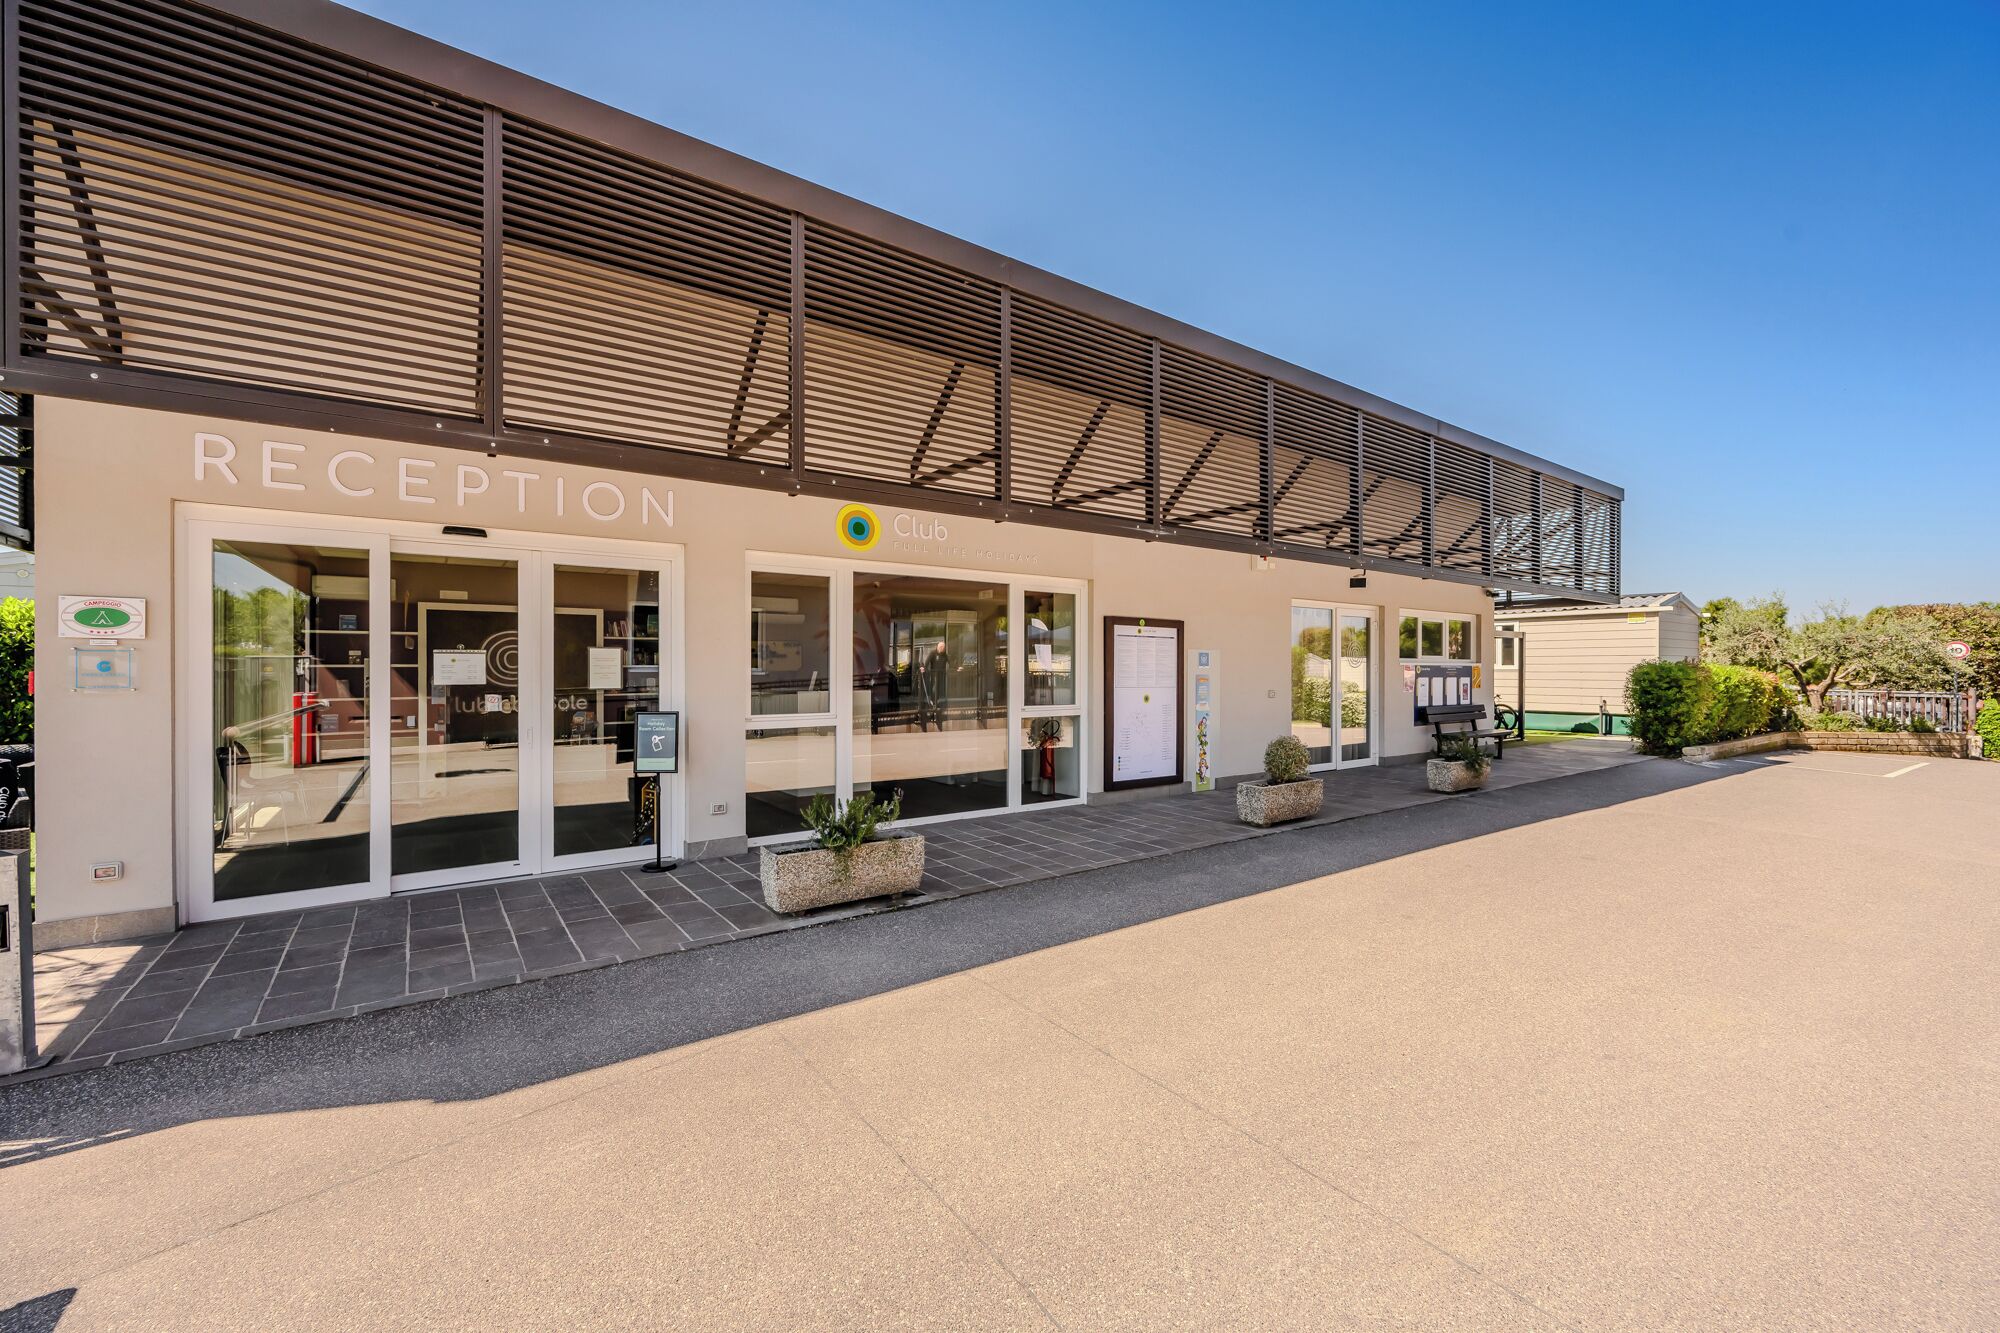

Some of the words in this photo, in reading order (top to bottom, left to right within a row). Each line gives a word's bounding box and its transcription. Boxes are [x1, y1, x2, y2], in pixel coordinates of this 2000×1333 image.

[194, 432, 675, 528] RECEPTION
[893, 513, 948, 541] Club
[893, 541, 928, 553] FULL
[938, 544, 968, 557] LIFE
[976, 550, 1039, 564] HOLIDAYS
[83, 600, 122, 608] CAMPEGGIO
